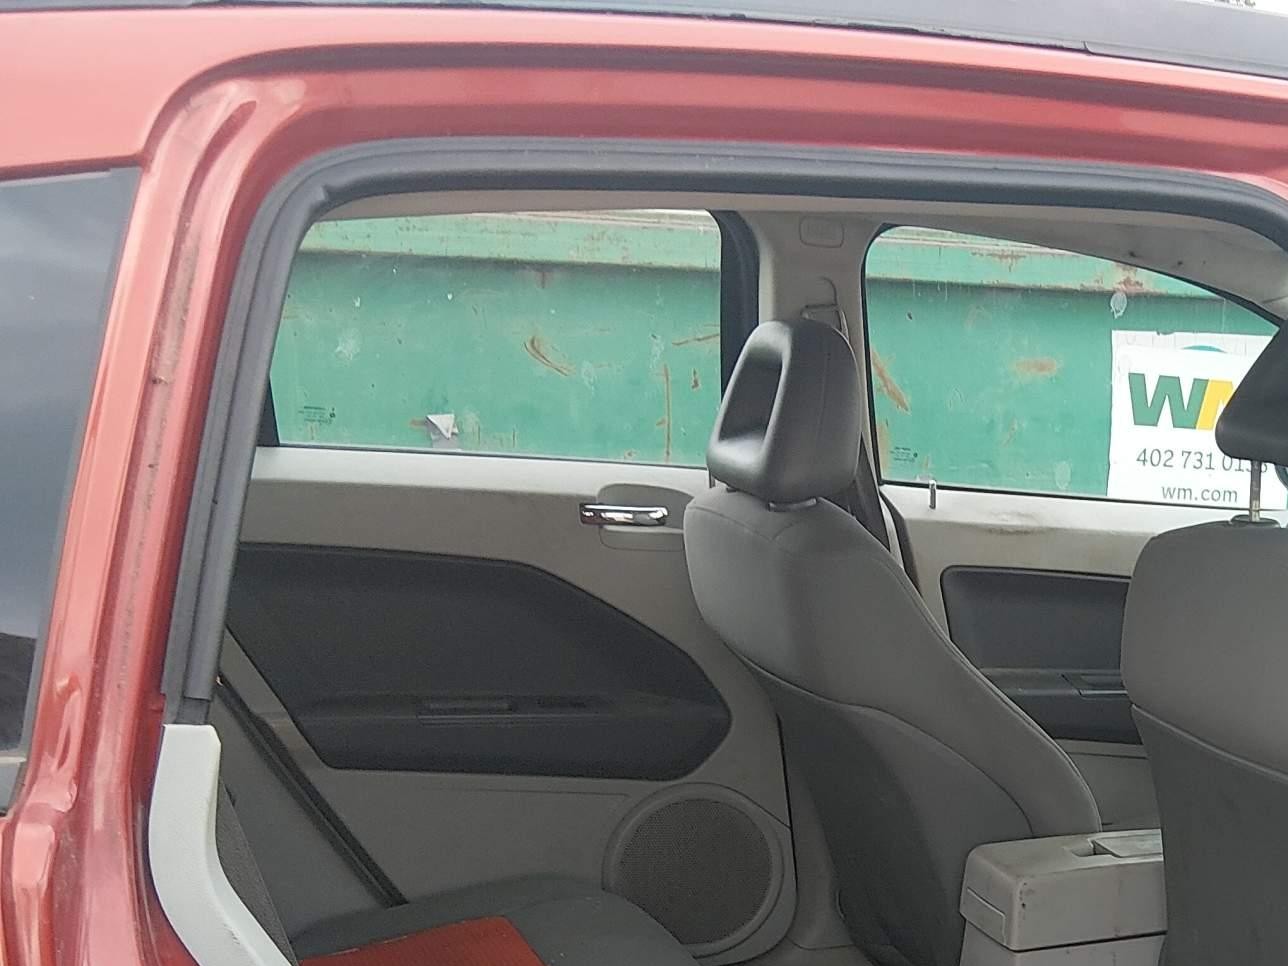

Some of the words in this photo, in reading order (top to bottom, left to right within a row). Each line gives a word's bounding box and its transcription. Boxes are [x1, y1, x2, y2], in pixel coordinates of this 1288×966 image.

[1136, 448, 1174, 468] 402
[1181, 451, 1216, 471] 731
[1161, 486, 1238, 503] wm.com
